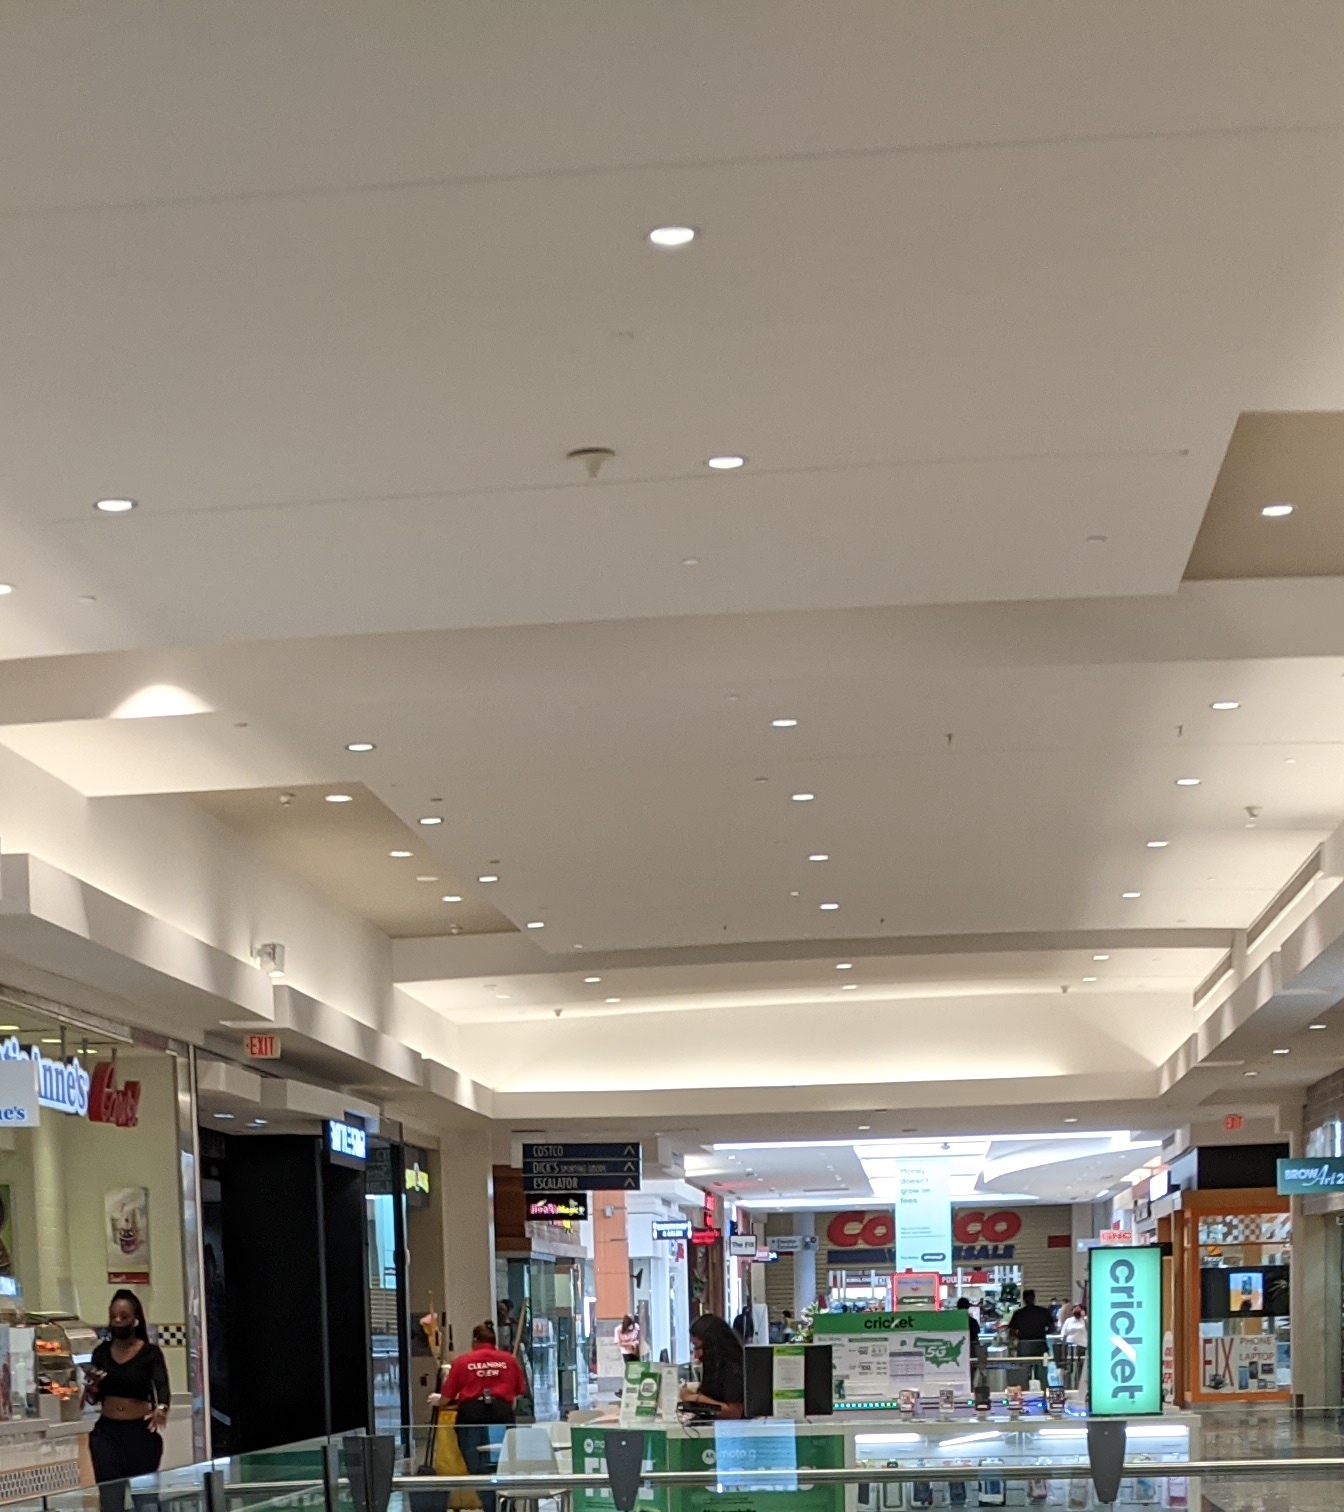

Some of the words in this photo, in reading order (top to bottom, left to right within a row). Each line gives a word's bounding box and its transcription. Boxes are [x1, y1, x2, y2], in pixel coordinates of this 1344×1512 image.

[250, 1036, 275, 1057] EXIT
[533, 1146, 564, 1157] COSTCO
[533, 1162, 559, 1174] DICK'S
[1285, 1169, 1317, 1180] BROW
[533, 1177, 579, 1189] ESCALATOR
[827, 1211, 1022, 1247] COCO
[864, 1316, 915, 1330] cricket
[1109, 1259, 1143, 1399] cricket
[1240, 1338, 1272, 1346] PHONE
[926, 1346, 947, 1358] 5G
[1240, 1352, 1274, 1361] LAPTOP
[468, 1362, 507, 1371] CLEANING
[1203, 1338, 1234, 1387] FIX
